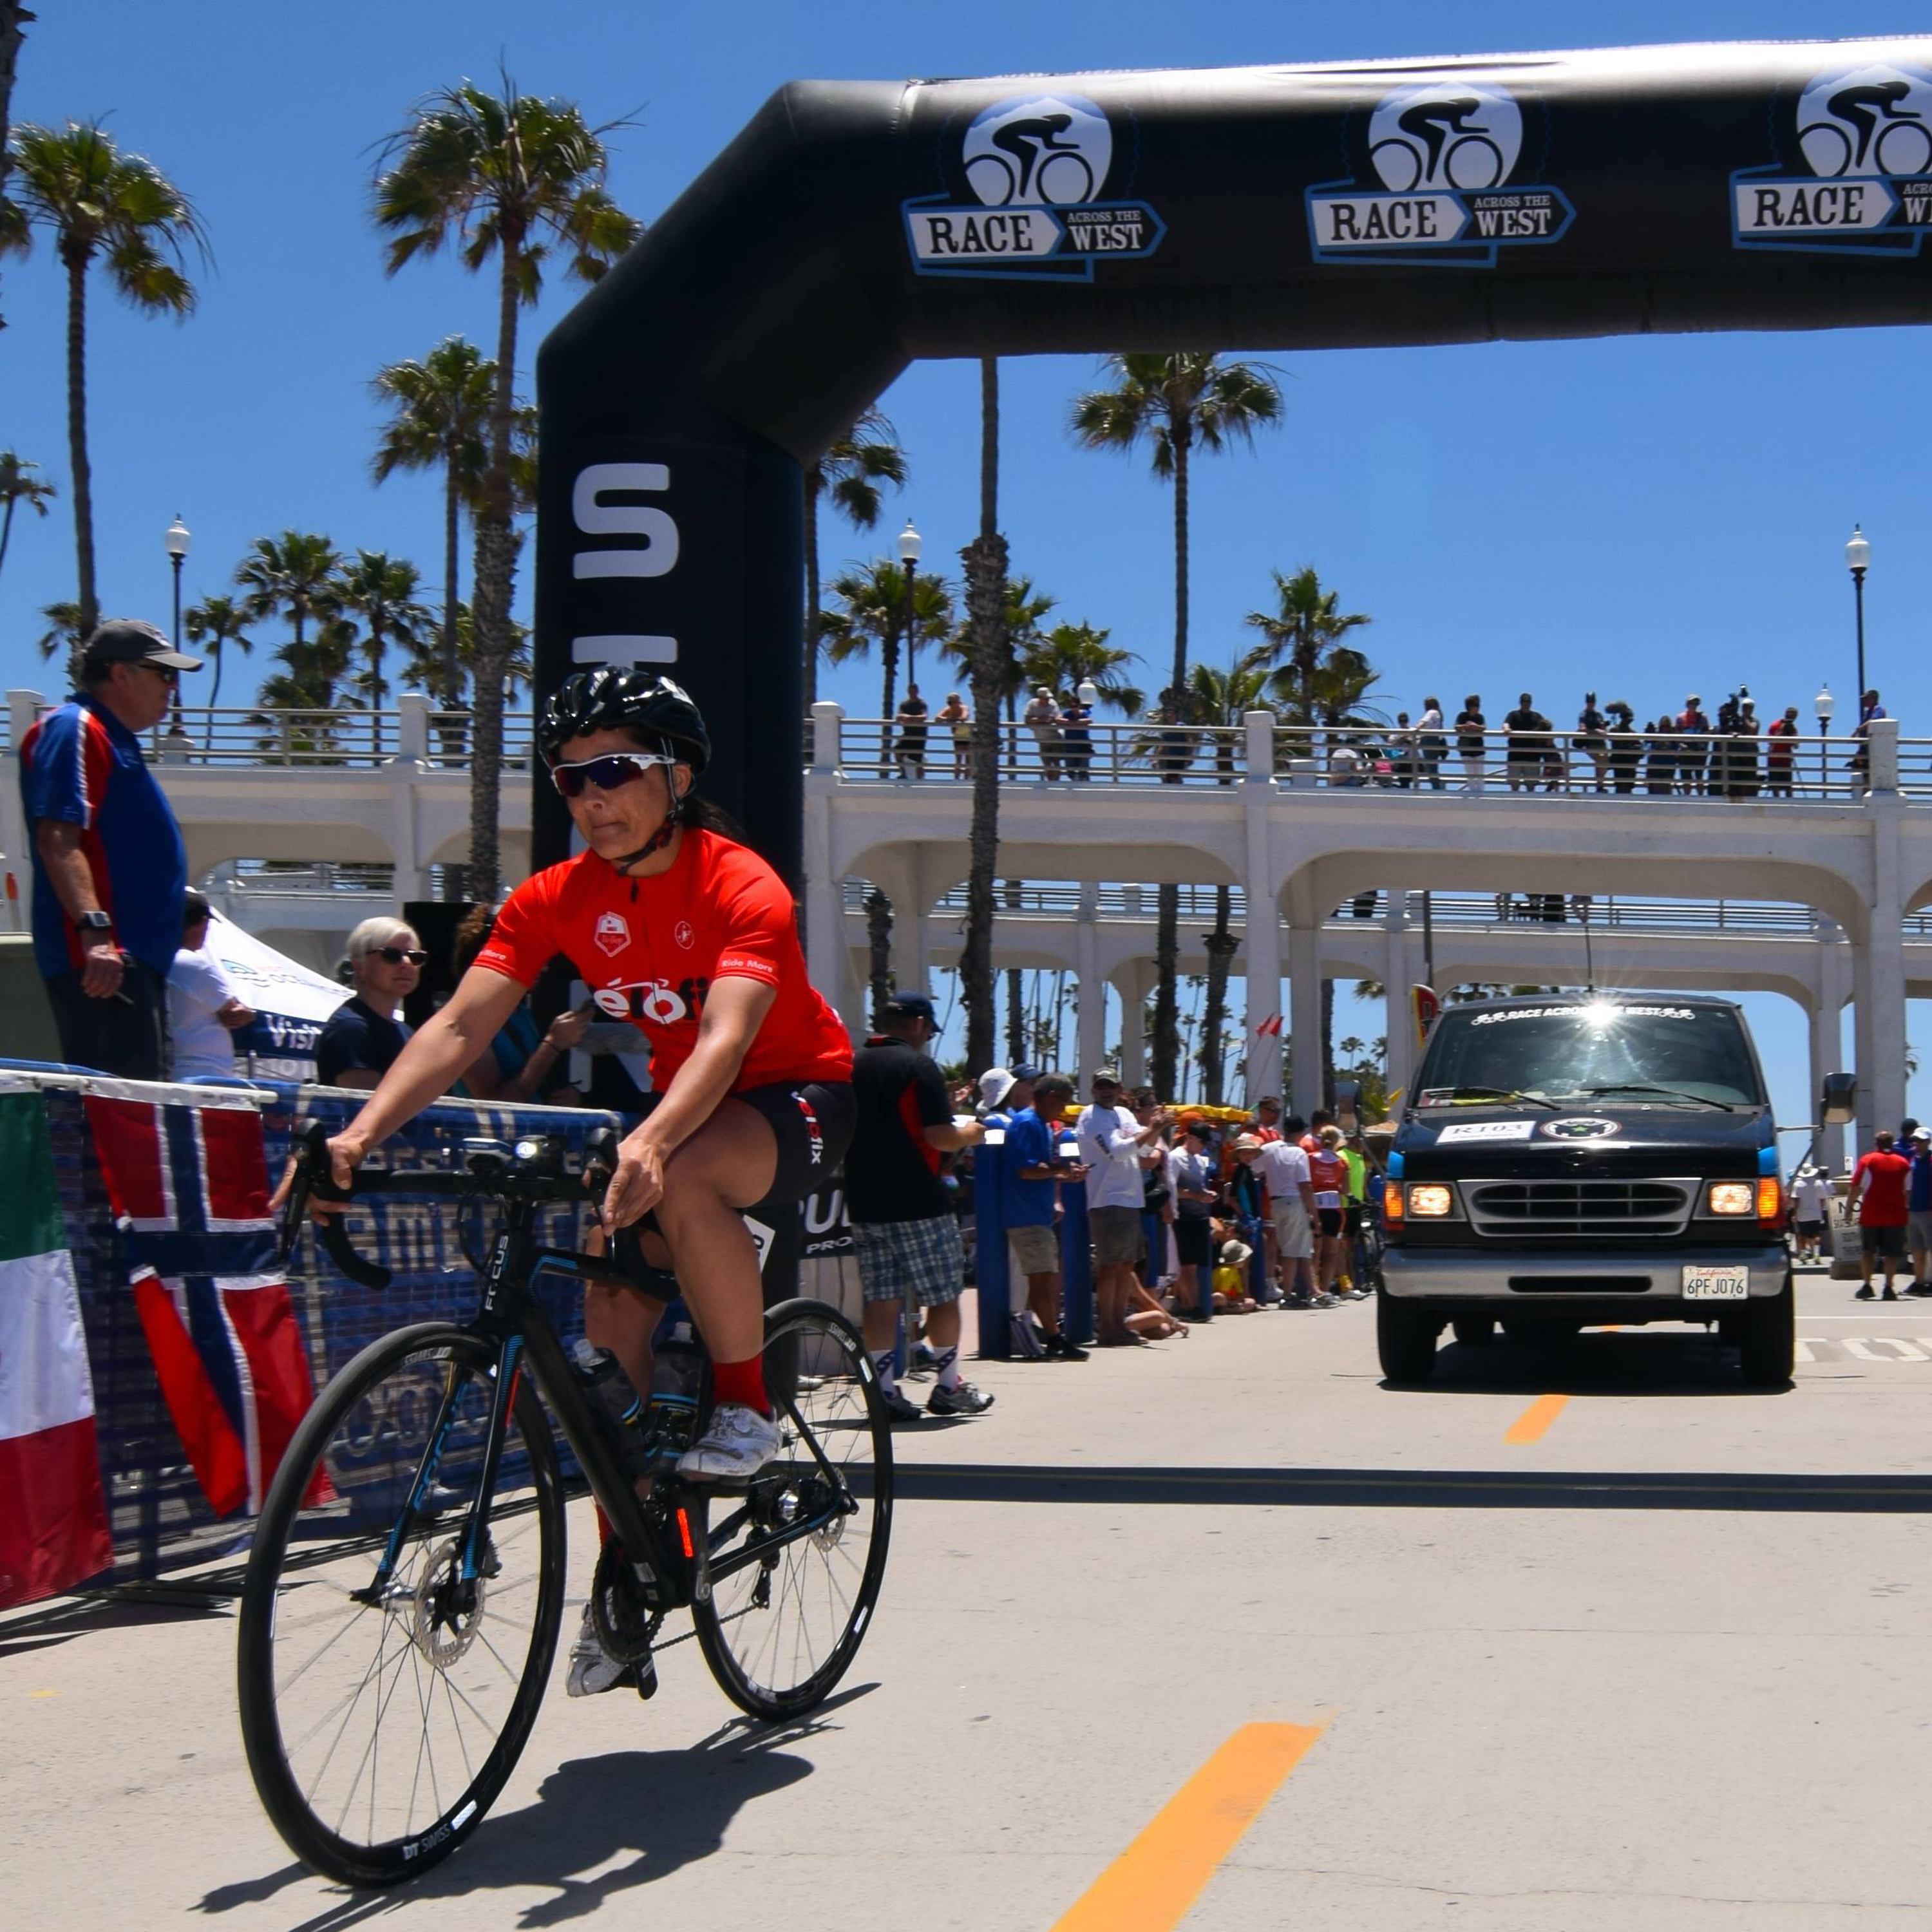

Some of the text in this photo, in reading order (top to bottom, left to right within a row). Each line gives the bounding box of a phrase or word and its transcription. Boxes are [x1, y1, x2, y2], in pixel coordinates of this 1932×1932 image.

[1473, 195, 1551, 208] ACROSS THE
[1753, 186, 1864, 227] RACE
[1068, 210, 1141, 223] ACROSS THE
[1330, 201, 1437, 241] RACE
[1475, 209, 1551, 236] WEST
[926, 215, 1033, 254] RACE
[1068, 224, 1143, 251] WEST
[1506, 1009, 1543, 1020] RACE
[1543, 1006, 1593, 1017] ACROS
[1687, 1278, 1744, 1294] 6PFJ076
